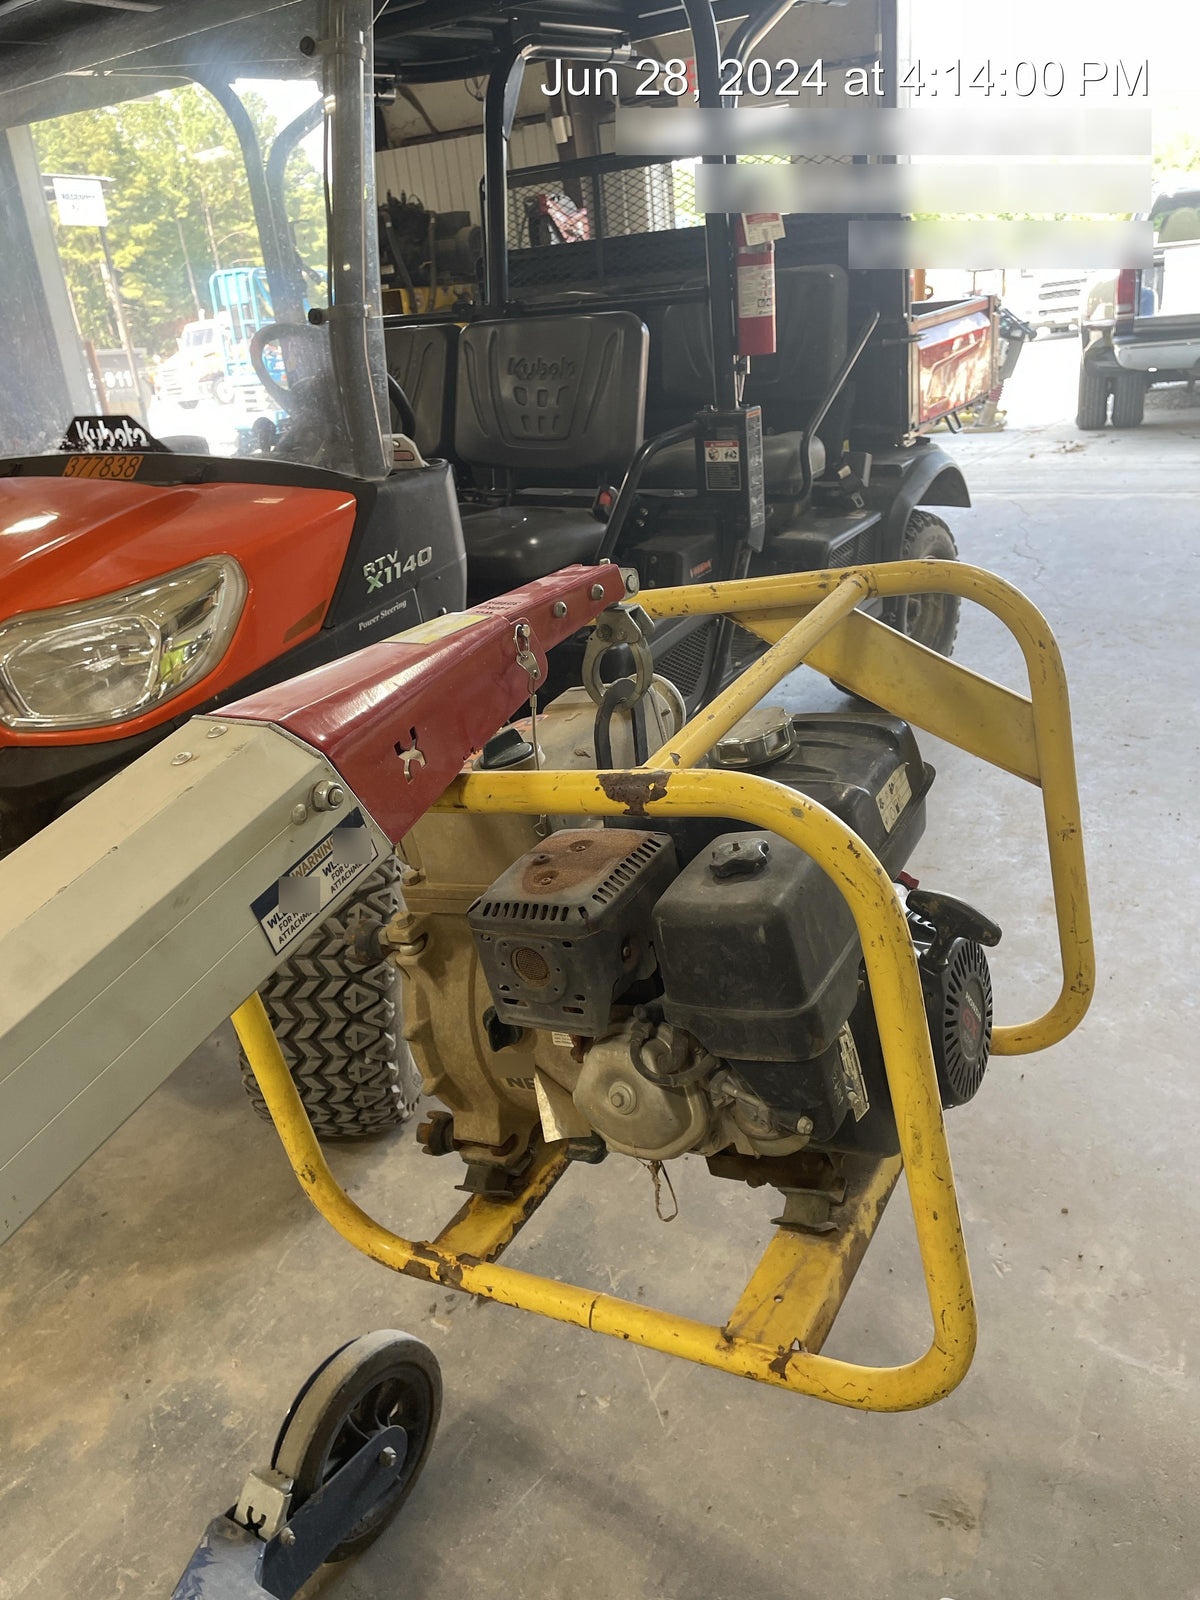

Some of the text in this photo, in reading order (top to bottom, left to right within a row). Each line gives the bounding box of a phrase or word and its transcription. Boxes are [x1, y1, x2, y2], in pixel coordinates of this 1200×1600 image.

[75, 419, 150, 452] Kubota
[64, 456, 140, 478] 377838
[363, 550, 398, 576] RTV
[366, 546, 432, 594] X1140
[358, 612, 381, 631] Power
[380, 600, 407, 619] Steering
[322, 861, 339, 877] WL
[331, 865, 345, 880] FOR
[279, 915, 293, 931] FOR
